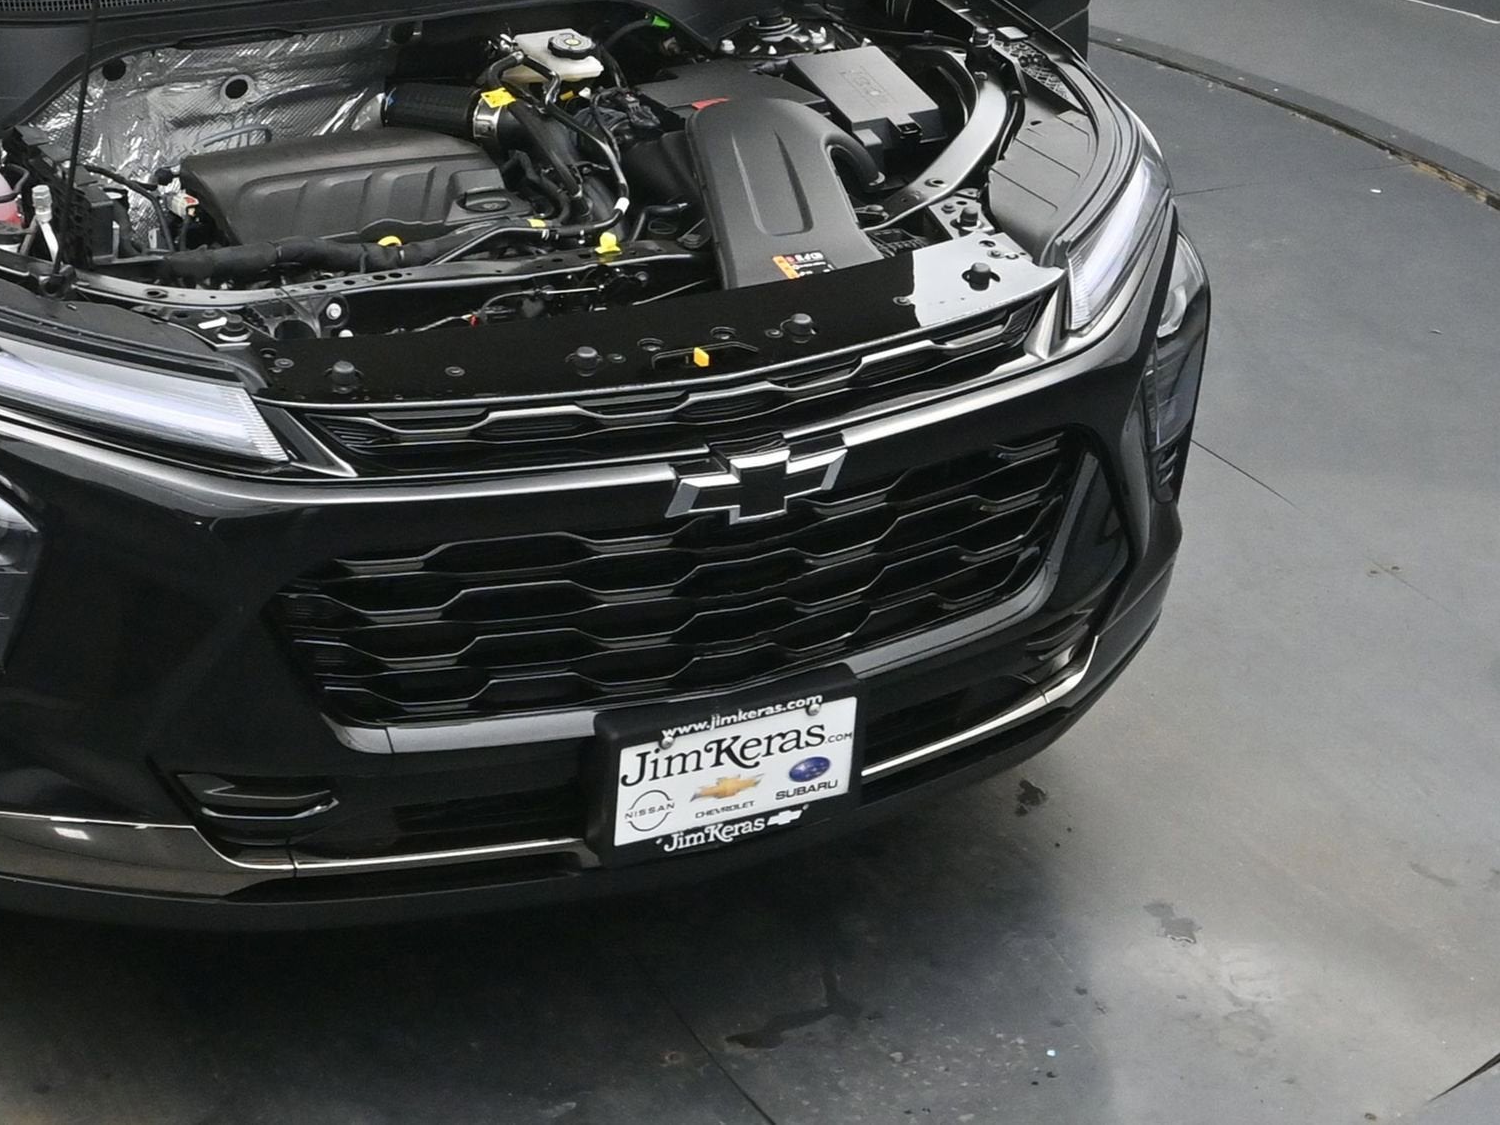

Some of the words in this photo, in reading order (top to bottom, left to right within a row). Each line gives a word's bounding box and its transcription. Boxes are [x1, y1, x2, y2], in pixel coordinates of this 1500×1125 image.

[662, 695, 822, 738] www.jimkeras.com
[775, 779, 838, 801] SUBARU
[624, 802, 675, 819] NISSAN
[695, 800, 754, 819] CHEVROLET
